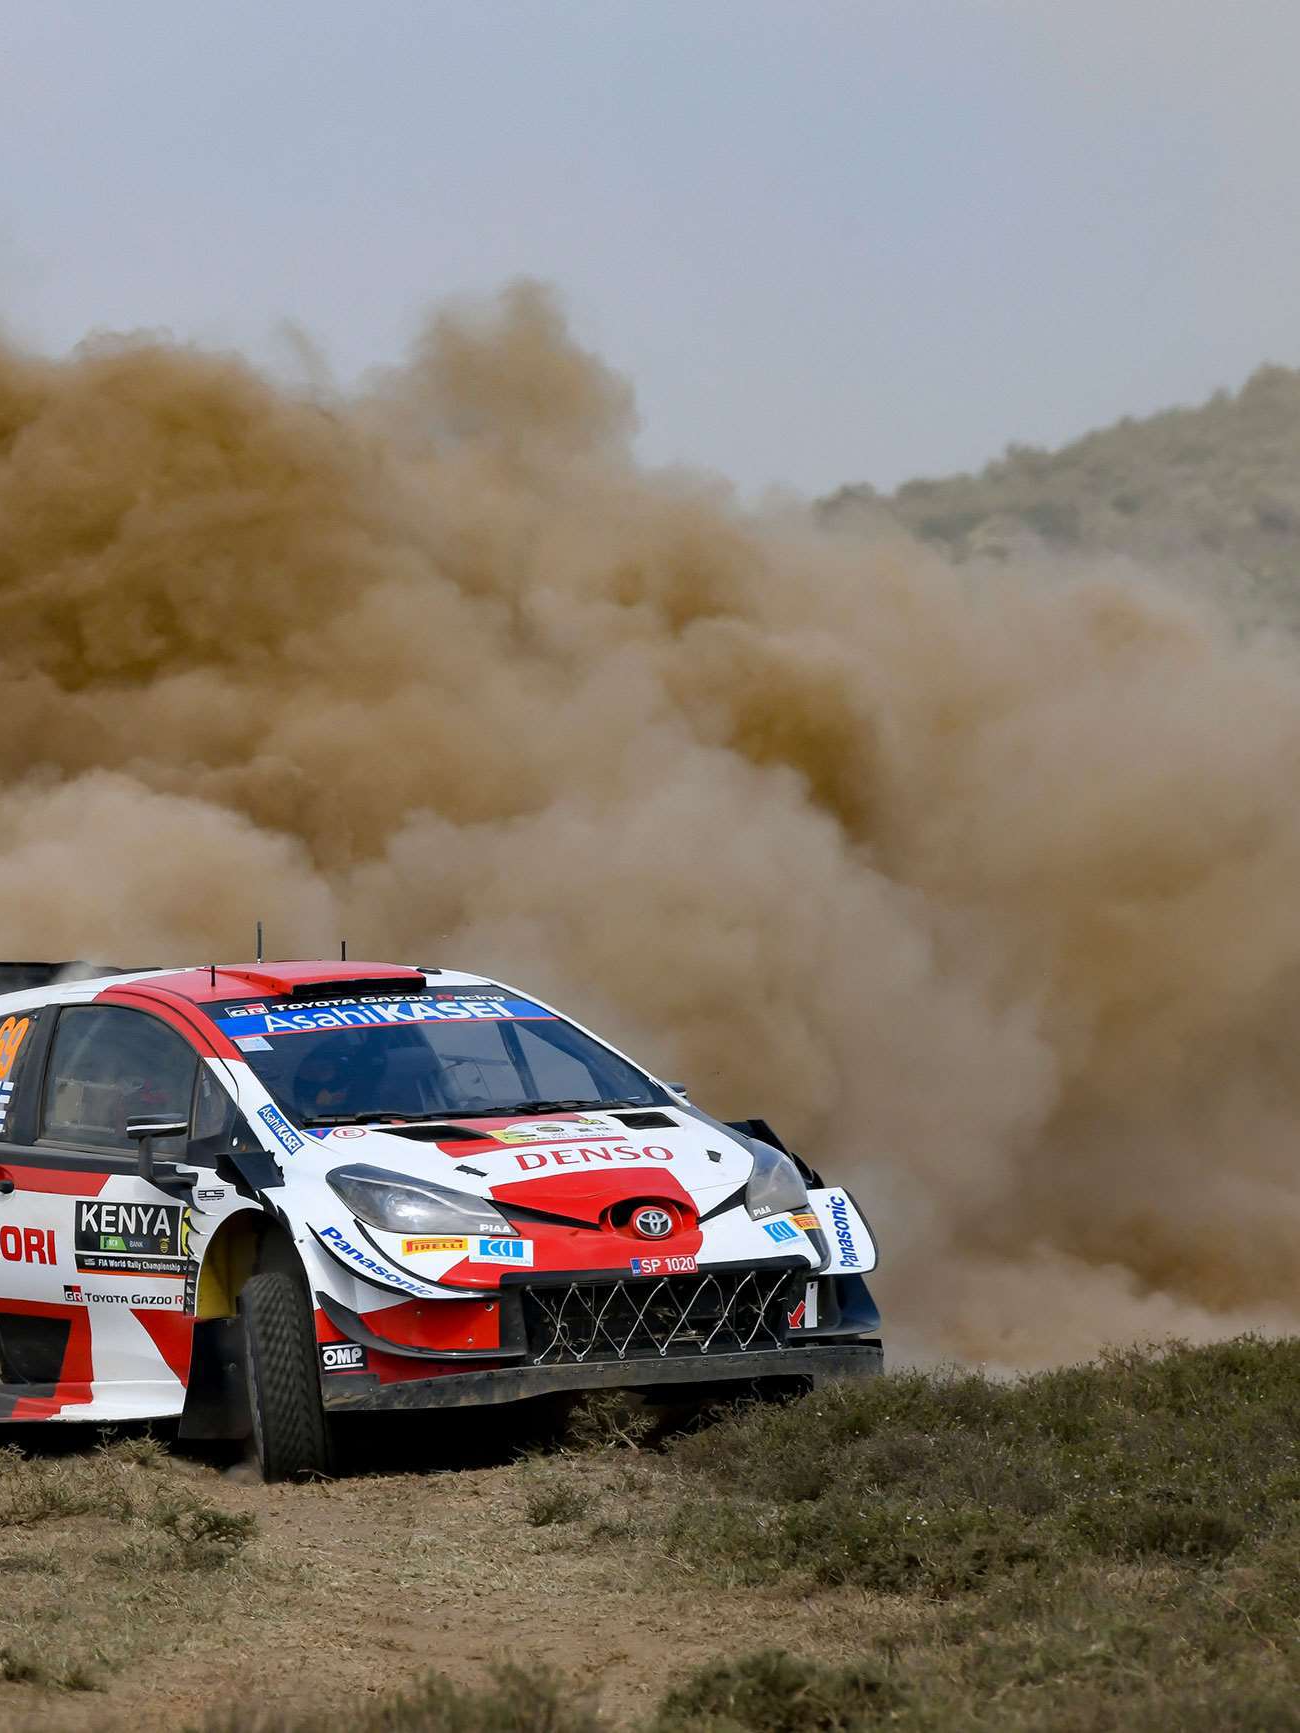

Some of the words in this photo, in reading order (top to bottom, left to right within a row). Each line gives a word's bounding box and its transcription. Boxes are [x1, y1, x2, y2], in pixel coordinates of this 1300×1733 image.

[271, 998, 357, 1012] TOYOTA
[359, 995, 434, 1005] GAZOO
[264, 1001, 515, 1033] AsahiKASEI
[259, 1105, 301, 1153] AsahiKASEI
[515, 1146, 674, 1171] DENSO
[81, 1203, 171, 1236] KENYA
[753, 1205, 772, 1217] PIAA
[479, 1223, 511, 1233] PIAA
[826, 1196, 863, 1268] Panasonic
[406, 1240, 463, 1252] PIRELLI
[98, 1258, 108, 1267] FIA
[109, 1259, 126, 1268] World
[126, 1260, 141, 1271] Rally
[142, 1261, 181, 1273] Championship
[320, 1226, 433, 1297] Panasonic
[641, 1259, 661, 1273] SP
[664, 1256, 696, 1272] 1020
[65, 1291, 82, 1302] GR
[323, 1347, 363, 1366] OMP
